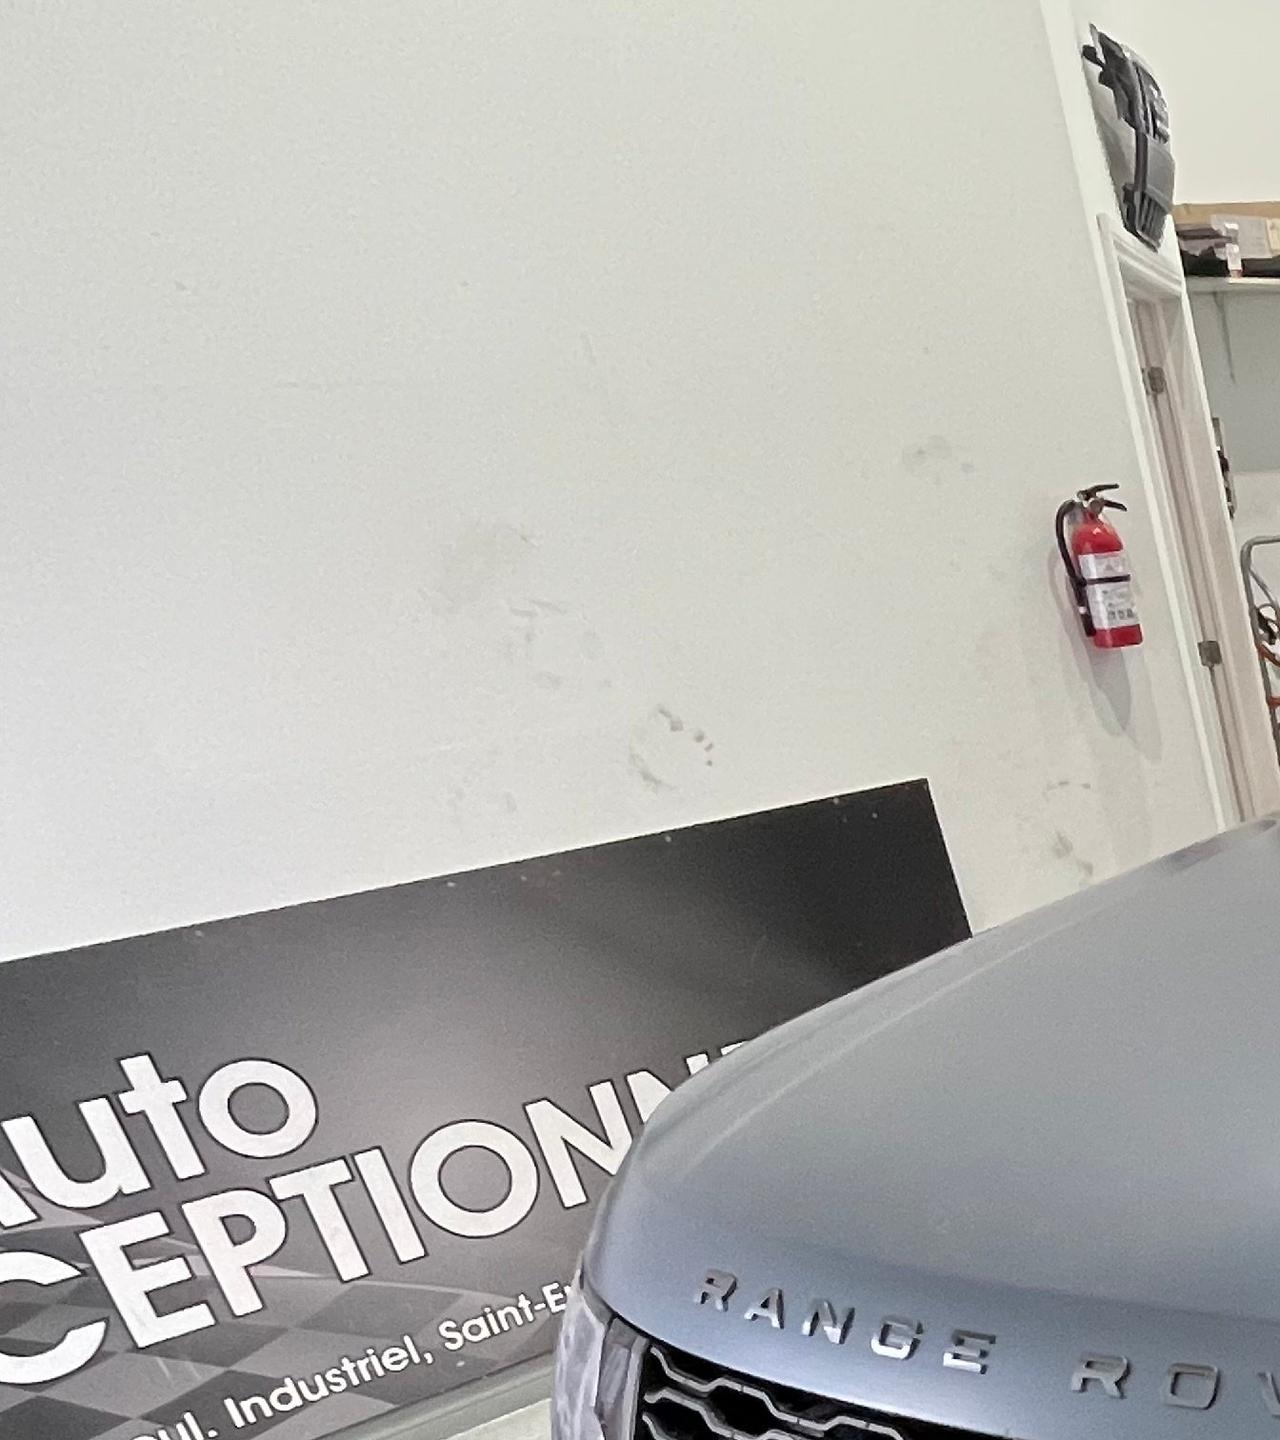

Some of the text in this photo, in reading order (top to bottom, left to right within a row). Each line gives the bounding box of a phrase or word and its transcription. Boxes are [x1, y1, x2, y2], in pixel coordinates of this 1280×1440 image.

[0, 1040, 750, 1385] CEPTION
[223, 1333, 435, 1429] Industriel,
[437, 1281, 572, 1351] Saint-E
[694, 1267, 997, 1376] RANGE
